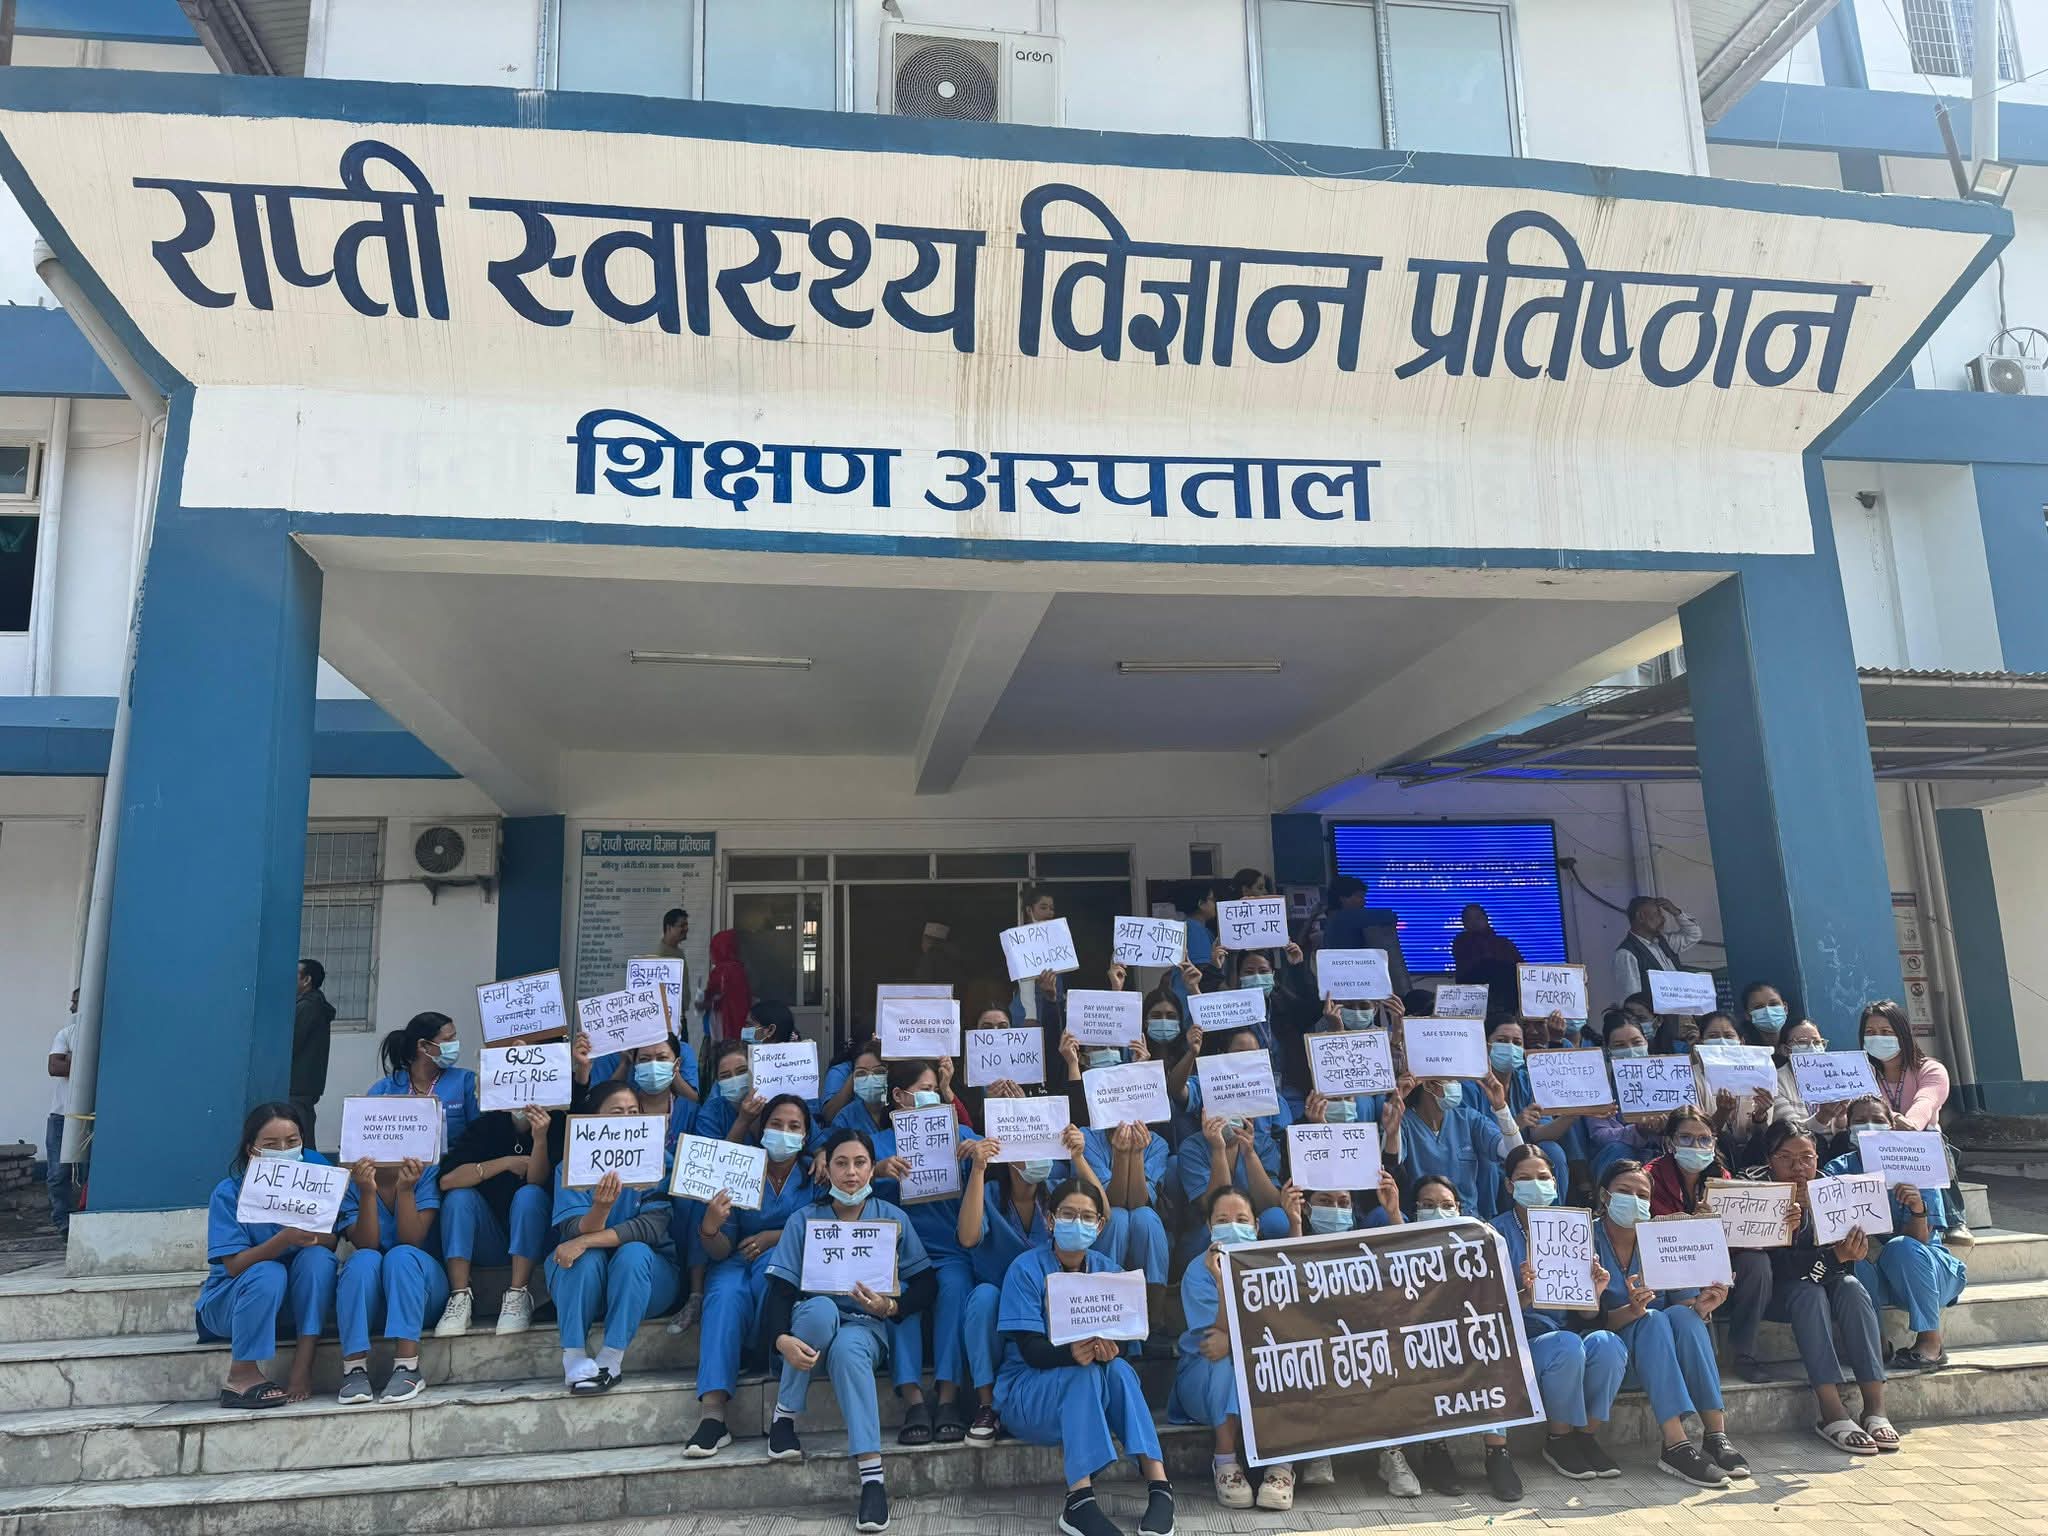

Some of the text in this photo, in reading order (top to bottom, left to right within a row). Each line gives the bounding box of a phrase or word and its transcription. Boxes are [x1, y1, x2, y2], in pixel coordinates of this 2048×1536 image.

[1015, 50, 1053, 63] aron
[132, 139, 1874, 394] राप्ती स्वास्थ्य विज्ञान प्रतिष्ठान
[567, 408, 1381, 522] शिक्षण अस्पताल
[602, 835, 622, 852] राप्ती
[1258, 903, 1281, 916] माग
[1028, 926, 1050, 943] PAY
[1118, 921, 1185, 946] श्रम शोषण
[1232, 920, 1281, 940] पुरा गर
[1042, 945, 1073, 965] WORK
[1115, 942, 1180, 967] बन्द गर
[1522, 969, 1571, 985] WE WANT
[1201, 1011, 1221, 1019] FASTER
[1222, 1009, 1239, 1017] THAN
[974, 1032, 1029, 1046] NO PAY
[1083, 1028, 1113, 1036] LEFTOVER
[1438, 1030, 1469, 1038] STAFFING
[505, 1047, 546, 1065] GUYS
[981, 1052, 1040, 1069] NO WORK
[530, 1068, 559, 1083] RISE
[1546, 1066, 1595, 1076] UNLIMITED
[1617, 1064, 1643, 1080] काम
[1096, 1082, 1159, 1096] NO VIBES WITH LOW
[1214, 1093, 1235, 1101] SALARY
[1652, 1090, 1680, 1104] न्याय
[364, 1114, 418, 1122] WE SAVE LIVES
[924, 1115, 948, 1132] तलब
[363, 1124, 428, 1132] NOW ITS TIME TO
[576, 1121, 649, 1142] We Are not
[1295, 1127, 1333, 1142] सरकारी
[362, 1133, 404, 1141] SAVE OURS
[926, 1133, 949, 1148] काम
[997, 1134, 1011, 1142] NOT
[688, 1141, 754, 1171] हामी जीवन
[1340, 1148, 1359, 1161] गर
[1879, 1146, 1926, 1154] OVERWORKED
[1880, 1154, 1919, 1162] UNDERPAID
[591, 1149, 645, 1172] ROBOT
[1882, 1163, 1931, 1172] UNDERVALUED
[254, 1163, 334, 1195] WE Want
[909, 1168, 948, 1185] सम्मान
[1852, 1180, 1881, 1196] माग
[263, 1195, 317, 1216] Justice
[1851, 1204, 1882, 1220] गर
[852, 1228, 880, 1239] माग
[1532, 1220, 1589, 1245] TIRED
[823, 1246, 873, 1264] पुरा गर
[1536, 1242, 1590, 1261] NURSE
[1660, 1254, 1697, 1263] STILL HERE
[1240, 1252, 1301, 1313] हाम्रो
[1302, 1242, 1384, 1304] श्रमको
[1384, 1245, 1448, 1301] मूल्य
[1537, 1259, 1579, 1288] Empty
[1069, 1294, 1115, 1304] WE ARE THE
[1546, 1283, 1594, 1302] PURSE
[1070, 1303, 1125, 1314] BACKBONE OF
[1070, 1314, 1121, 1325] HEALTH CARE
[1252, 1326, 1327, 1393] मौनता
[1400, 1318, 1464, 1370] न्याय
[1434, 1386, 1507, 1417] RAHS
